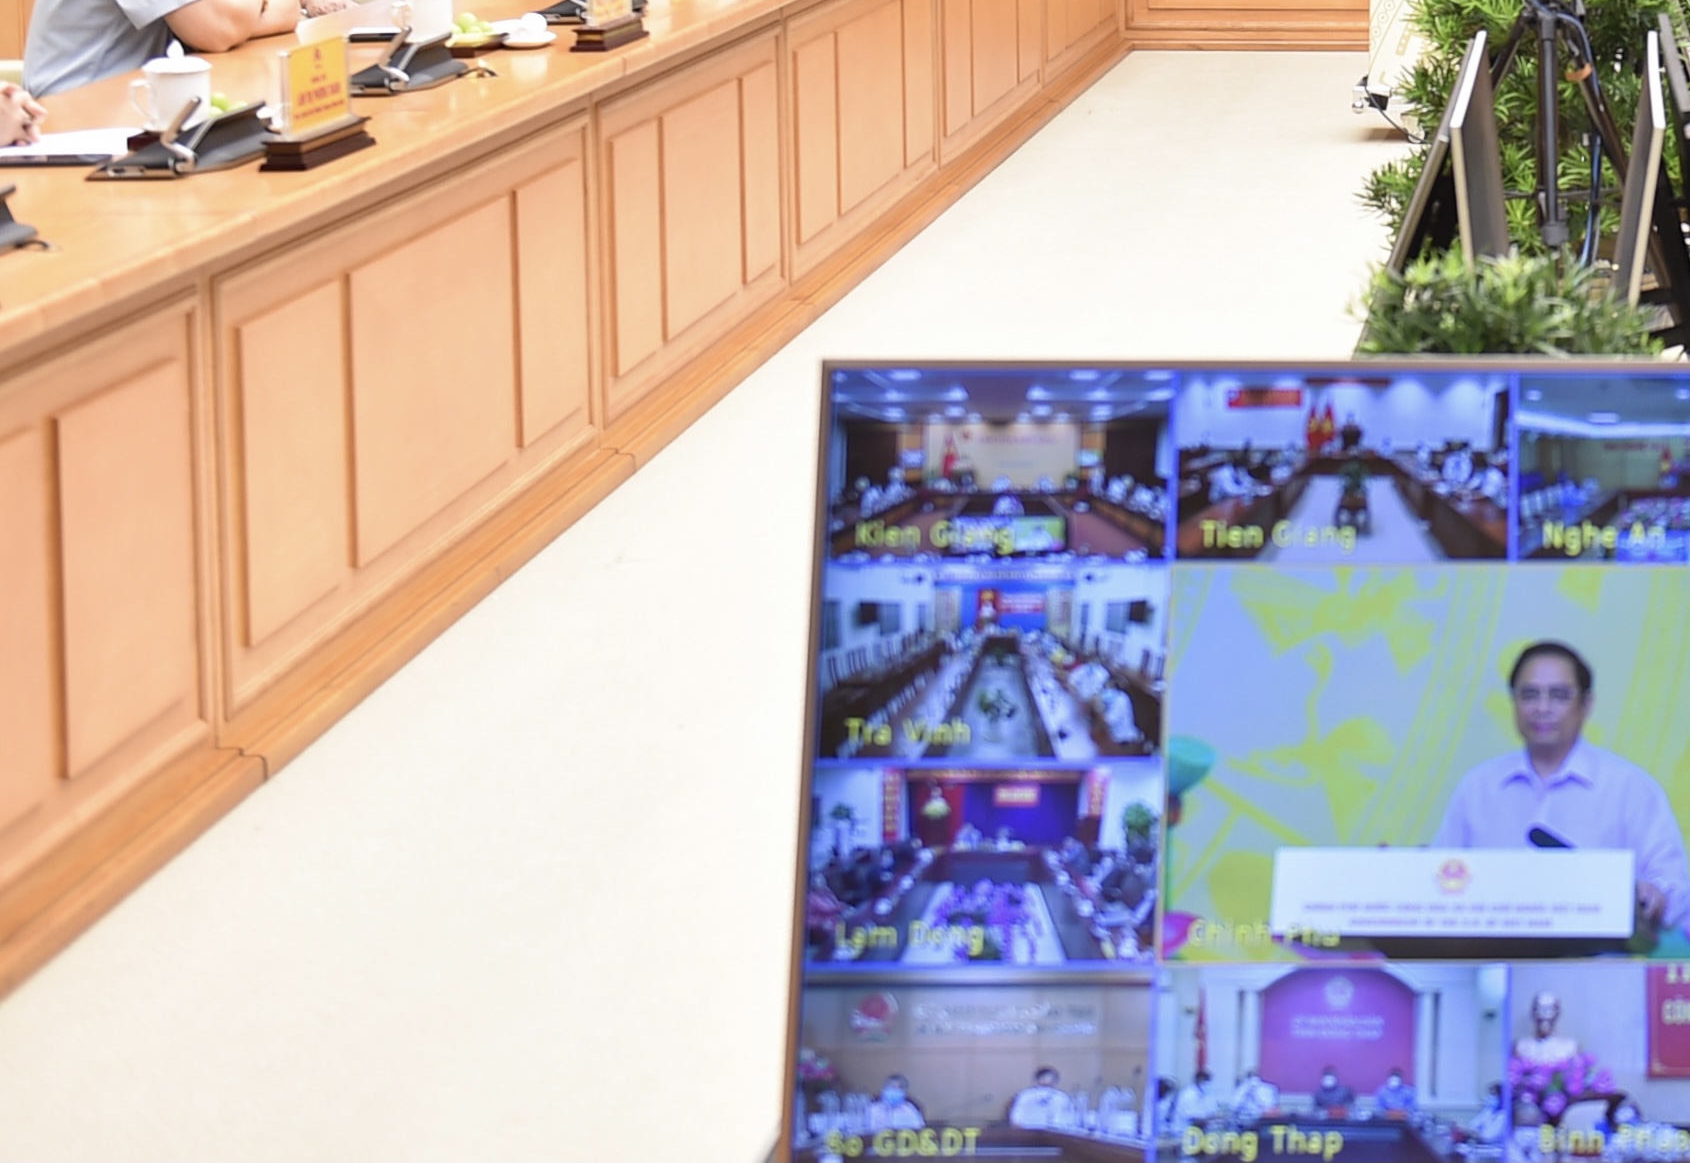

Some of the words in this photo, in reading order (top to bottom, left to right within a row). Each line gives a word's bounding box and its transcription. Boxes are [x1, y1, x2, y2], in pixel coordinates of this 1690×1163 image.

[855, 519, 921, 547] Kien
[1200, 519, 1264, 548] Tien
[1542, 520, 1617, 556] Nghe
[844, 717, 893, 746] Tra
[902, 717, 971, 746] Vinh
[909, 920, 984, 956] Dong
[1182, 1125, 1259, 1162] Dong
[1268, 1123, 1344, 1162] Thap
